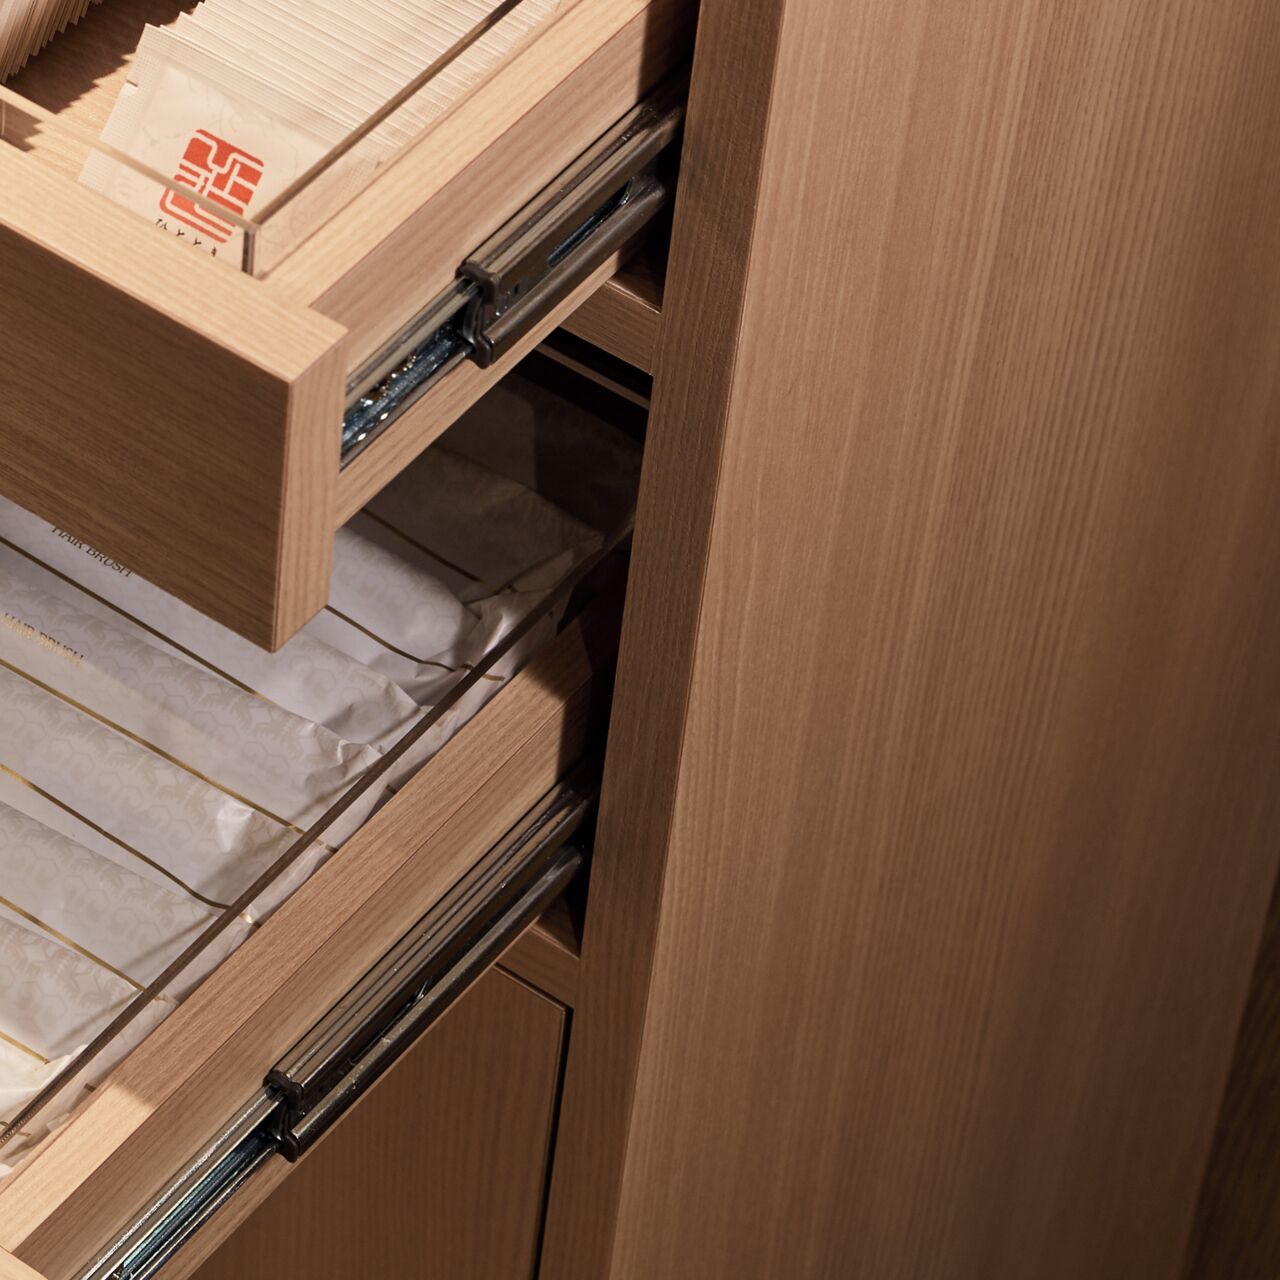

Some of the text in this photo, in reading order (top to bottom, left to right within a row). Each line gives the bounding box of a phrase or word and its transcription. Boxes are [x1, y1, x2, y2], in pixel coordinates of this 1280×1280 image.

[51, 526, 134, 578] HAIR BRUSH
[0, 612, 85, 665] HAIR BRUSH
